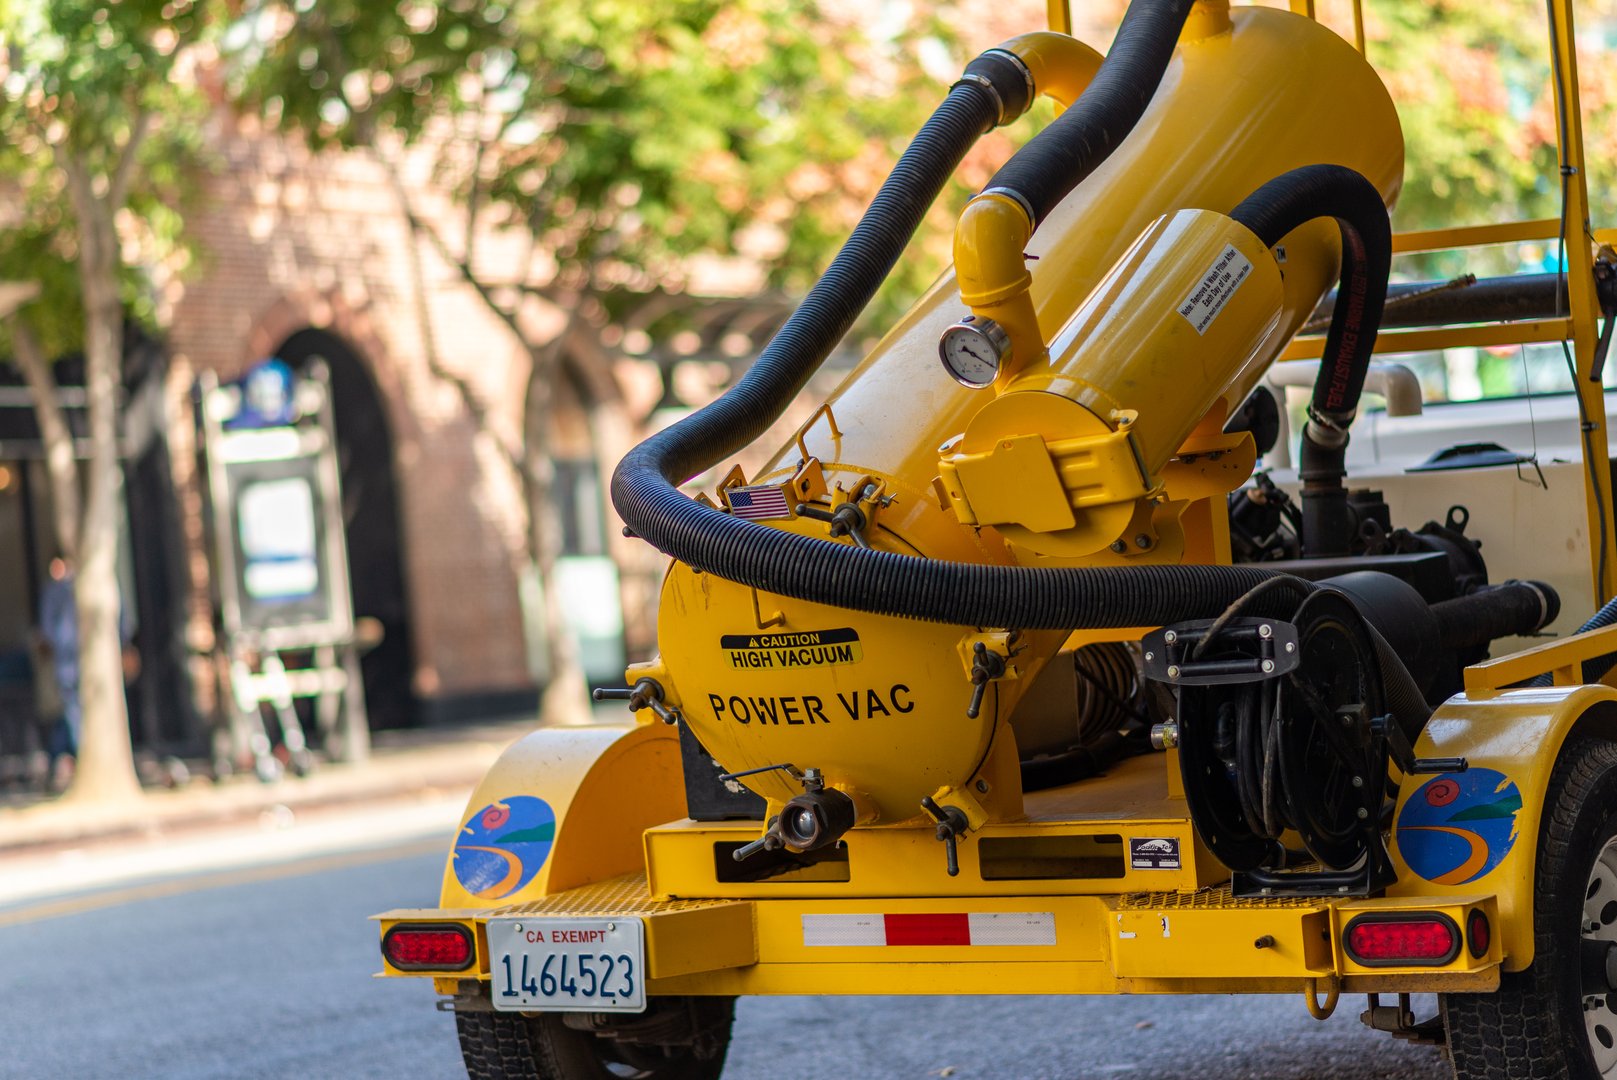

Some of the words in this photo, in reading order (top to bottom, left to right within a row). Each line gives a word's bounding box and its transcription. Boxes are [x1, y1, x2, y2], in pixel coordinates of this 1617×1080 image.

[1181, 303, 1194, 317] Note:
[1190, 286, 1207, 306] Remove
[1206, 270, 1219, 284] Wash
[1216, 260, 1228, 273] Filter
[1224, 249, 1236, 262] After
[1218, 279, 1225, 288] of
[1221, 272, 1232, 283] Use
[1210, 285, 1222, 296] Day
[1202, 293, 1215, 307] Each
[1345, 293, 1366, 331] MARINE
[762, 633, 820, 648] CAUTION
[730, 651, 773, 668] HIGH
[775, 645, 854, 667] VACUUM
[708, 693, 830, 725] POWER
[837, 683, 915, 721] VAC
[526, 930, 545, 944] CA
[552, 930, 606, 943] EXEMPT
[502, 954, 634, 998] 1464523
